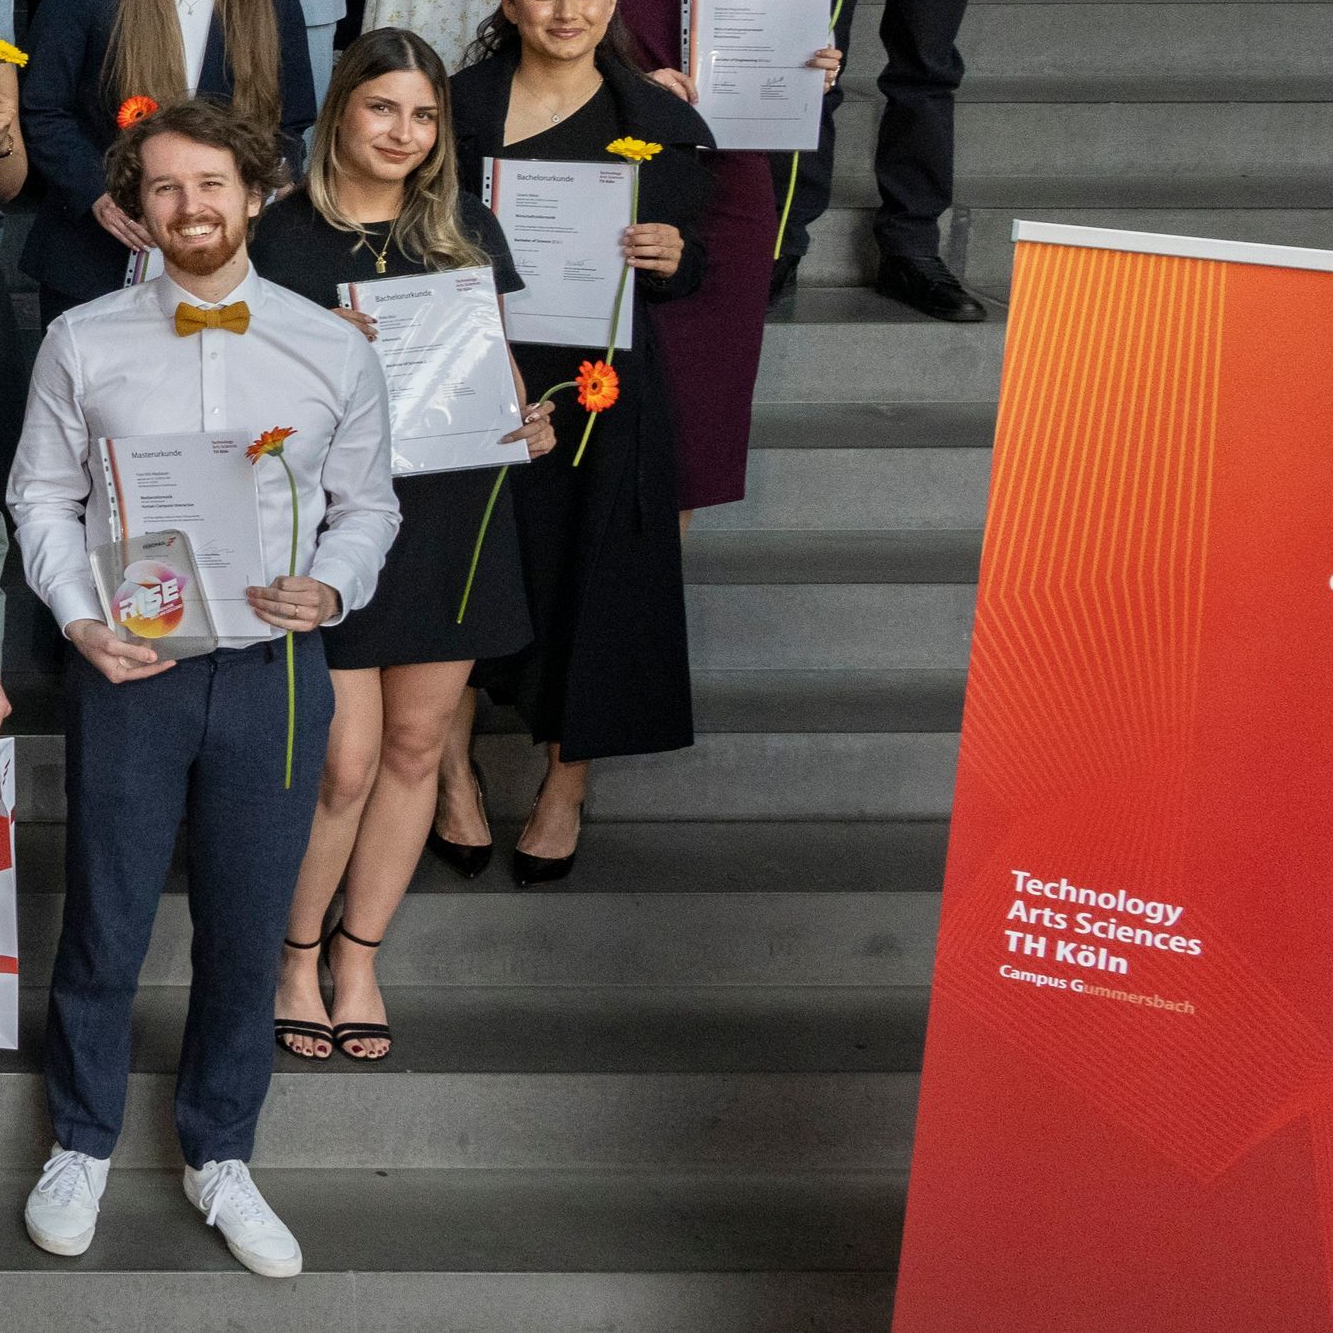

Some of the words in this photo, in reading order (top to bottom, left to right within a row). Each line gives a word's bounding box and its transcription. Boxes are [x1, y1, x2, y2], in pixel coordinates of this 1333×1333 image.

[517, 173, 575, 183] Bachelorurkunde
[374, 288, 434, 304] Bachelorurkunde
[131, 449, 183, 460] Masterurkunde
[1011, 869, 1185, 926] Technology
[1007, 900, 1069, 935] Arts
[1076, 913, 1203, 956] Sciences
[1004, 930, 1047, 957] TH
[1056, 942, 1130, 976] Köln
[998, 964, 1068, 992] Campus
[1069, 977, 1196, 1017] Gummersbach
